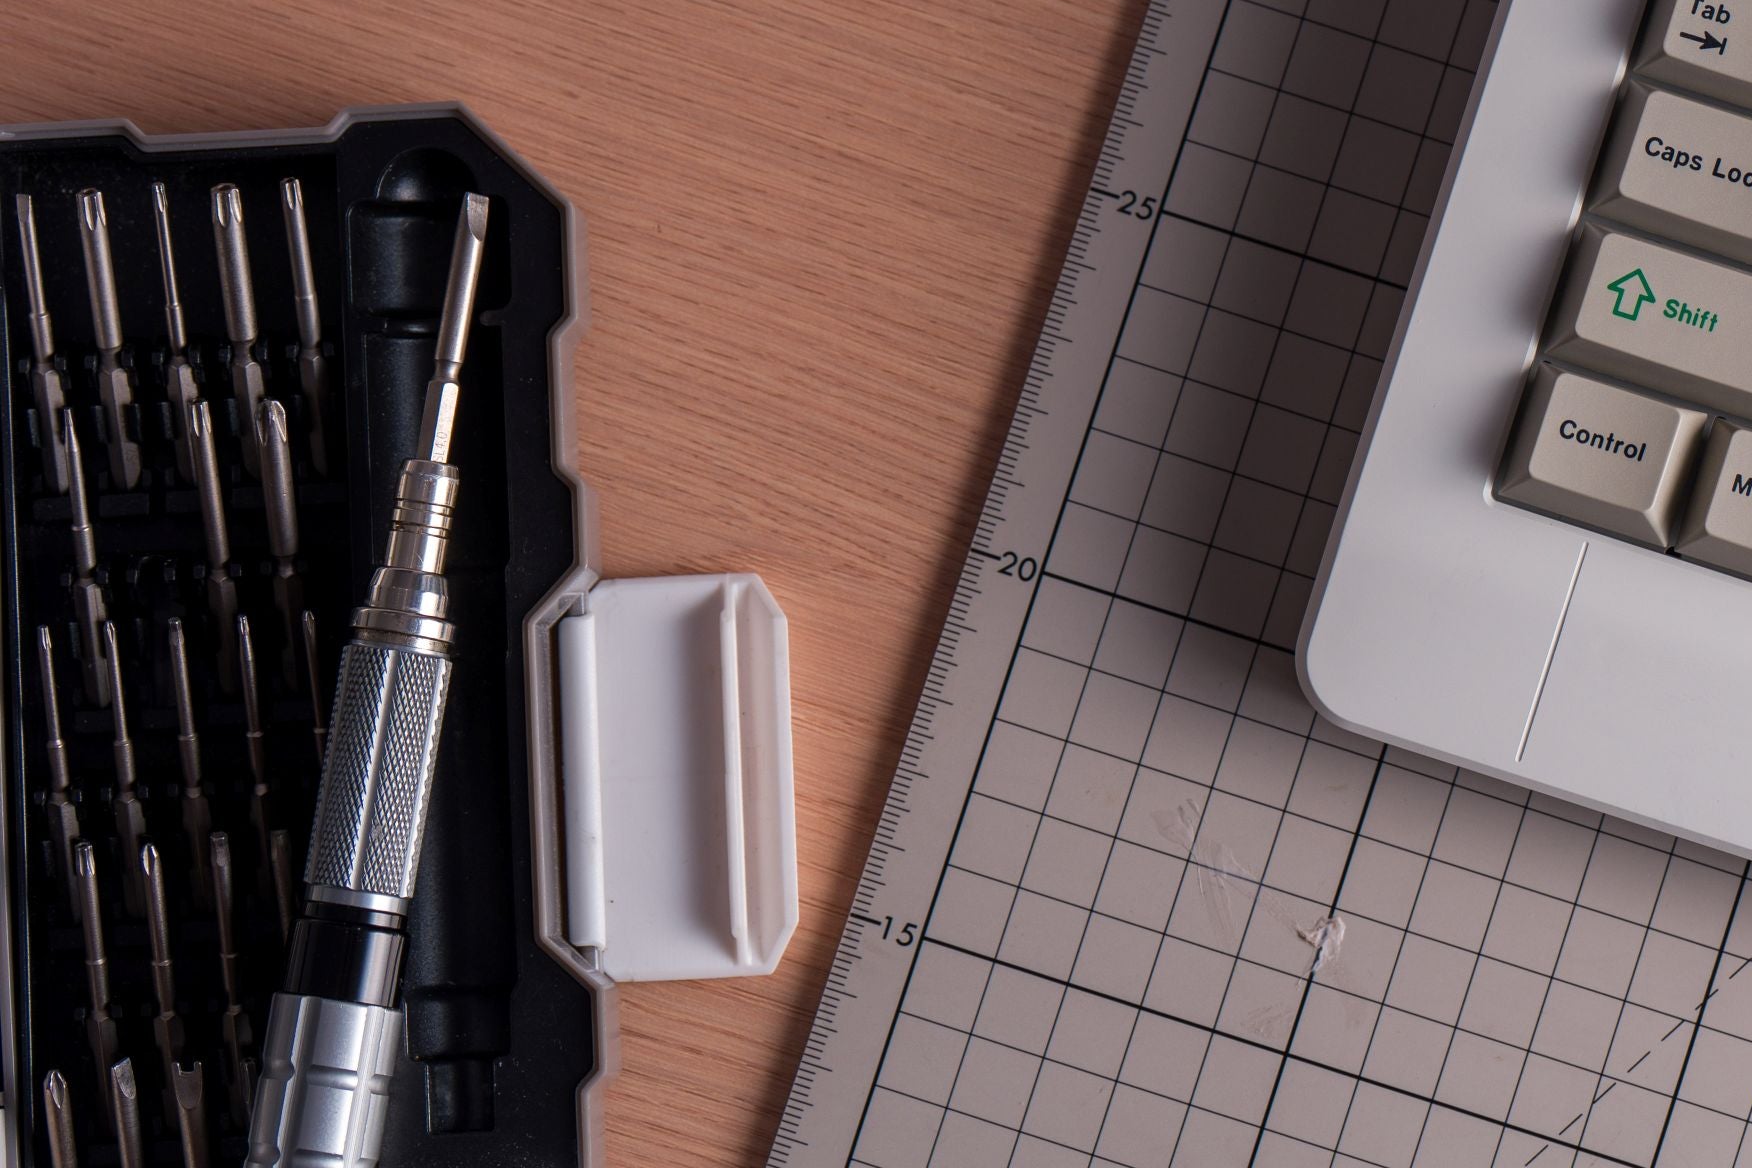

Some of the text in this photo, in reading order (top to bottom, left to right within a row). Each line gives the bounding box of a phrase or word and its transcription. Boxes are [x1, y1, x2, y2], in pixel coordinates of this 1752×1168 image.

[1644, 136, 1703, 171] Caps
[1116, 190, 1157, 220] 25
[1663, 298, 1718, 332] Shift
[1559, 419, 1647, 462] Control
[997, 551, 1037, 582] 20
[881, 915, 918, 947] 15
